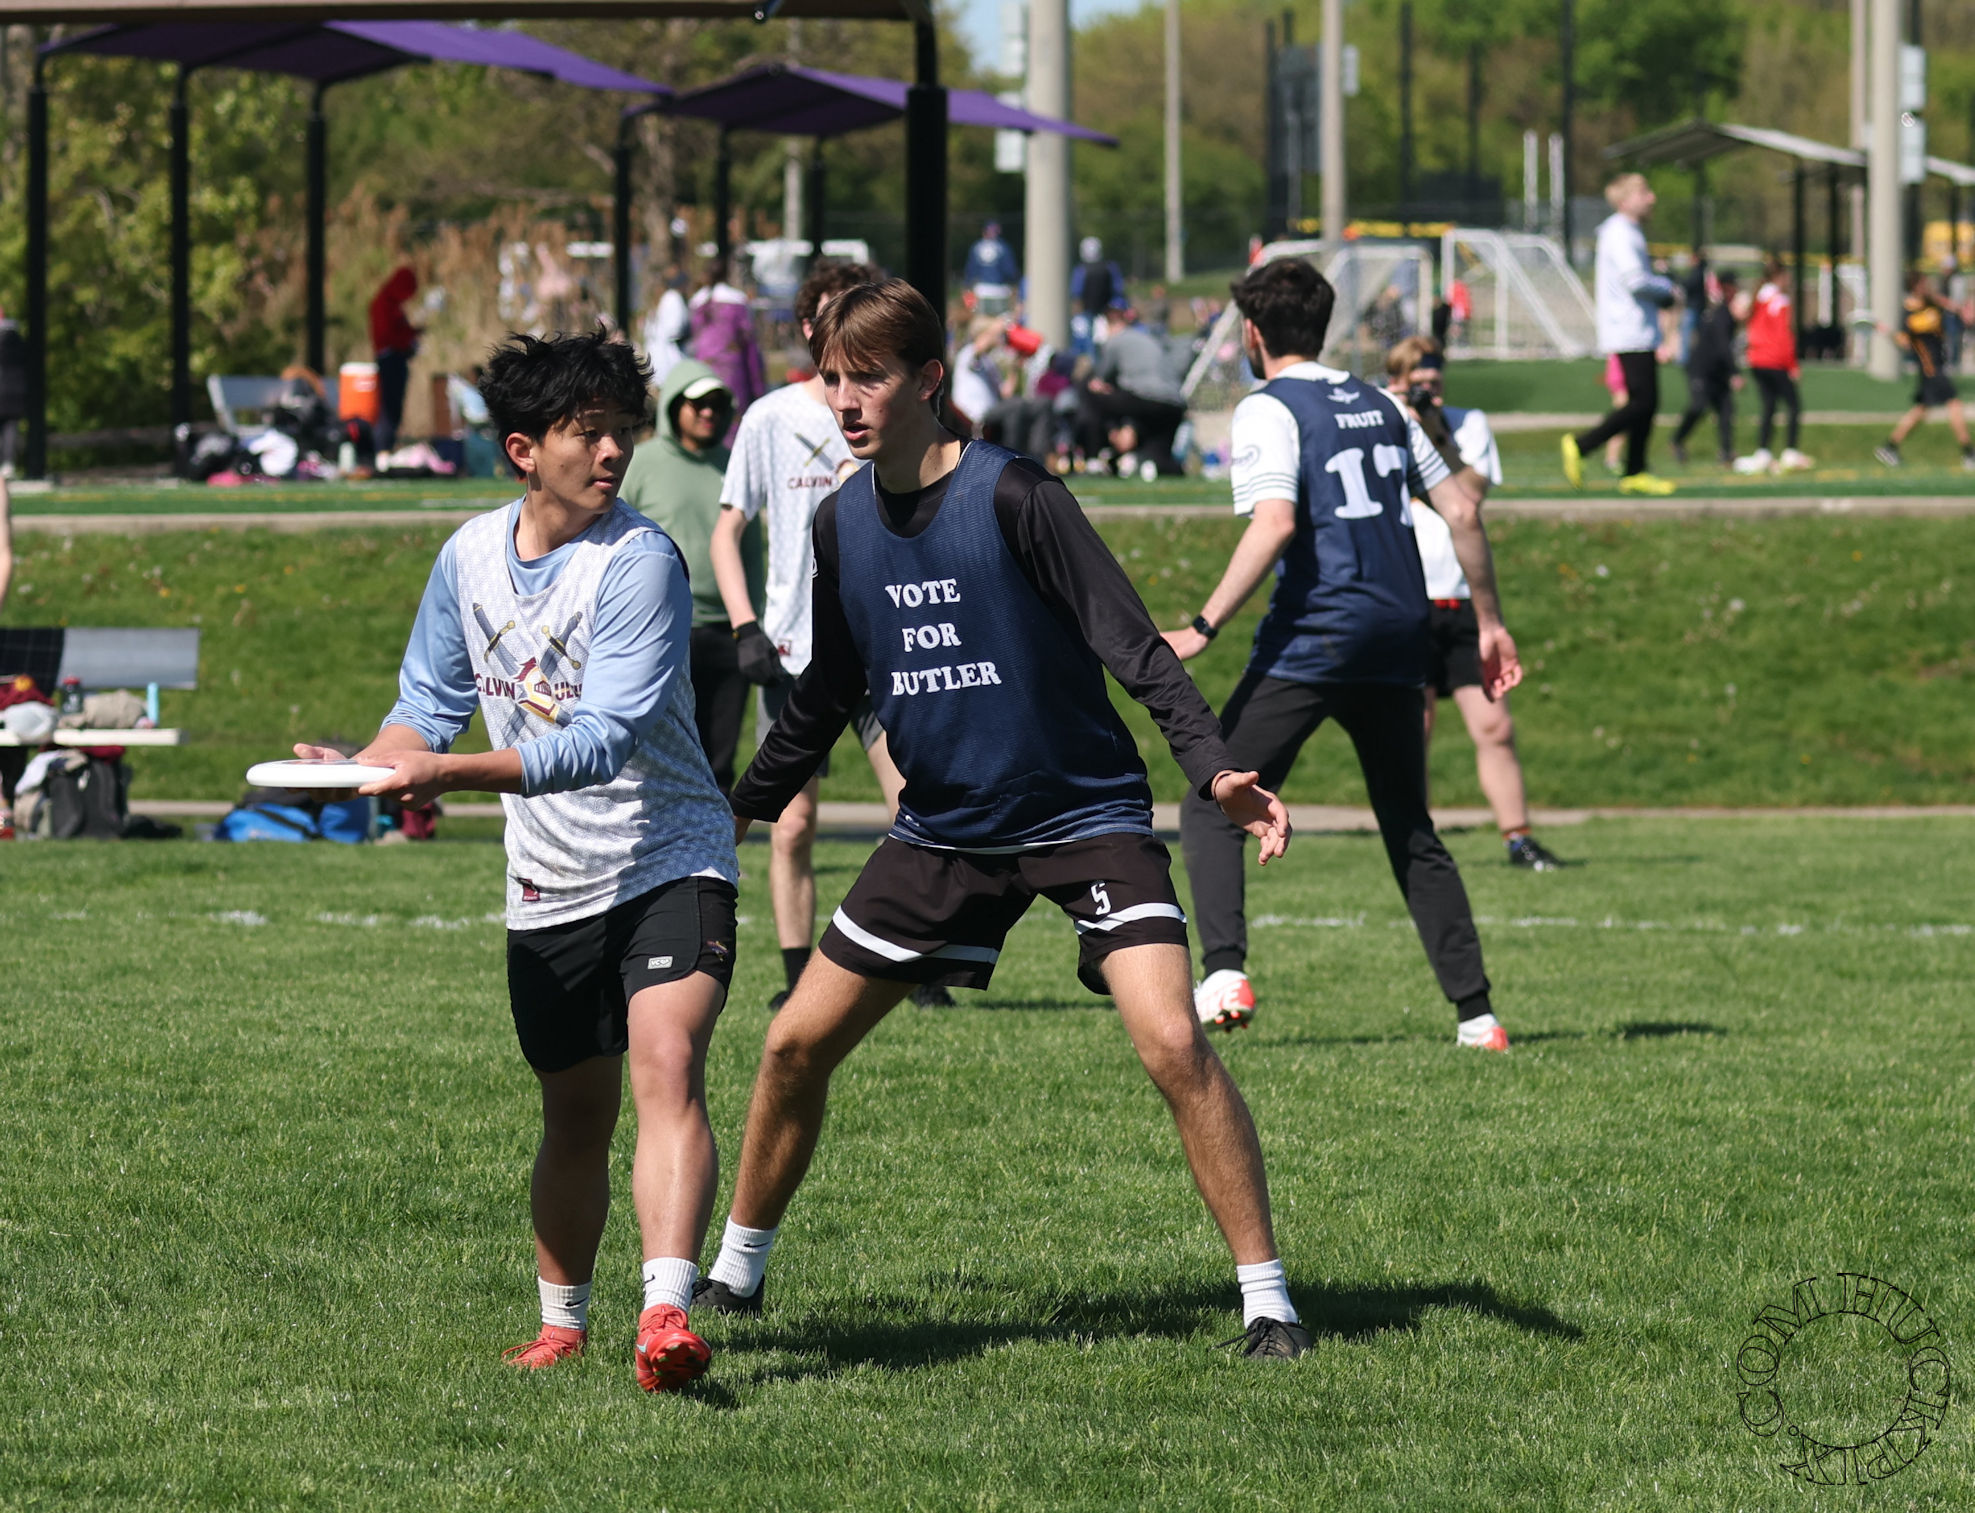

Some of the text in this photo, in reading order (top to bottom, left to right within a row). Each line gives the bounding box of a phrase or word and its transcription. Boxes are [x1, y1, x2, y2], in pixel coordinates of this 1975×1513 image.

[788, 476, 832, 490] CALVIN
[885, 578, 961, 608] VOTE
[902, 623, 962, 652] FOR
[475, 673, 515, 700] CLVIN
[891, 661, 1002, 696] BUTLER
[1090, 881, 1112, 916] 5
